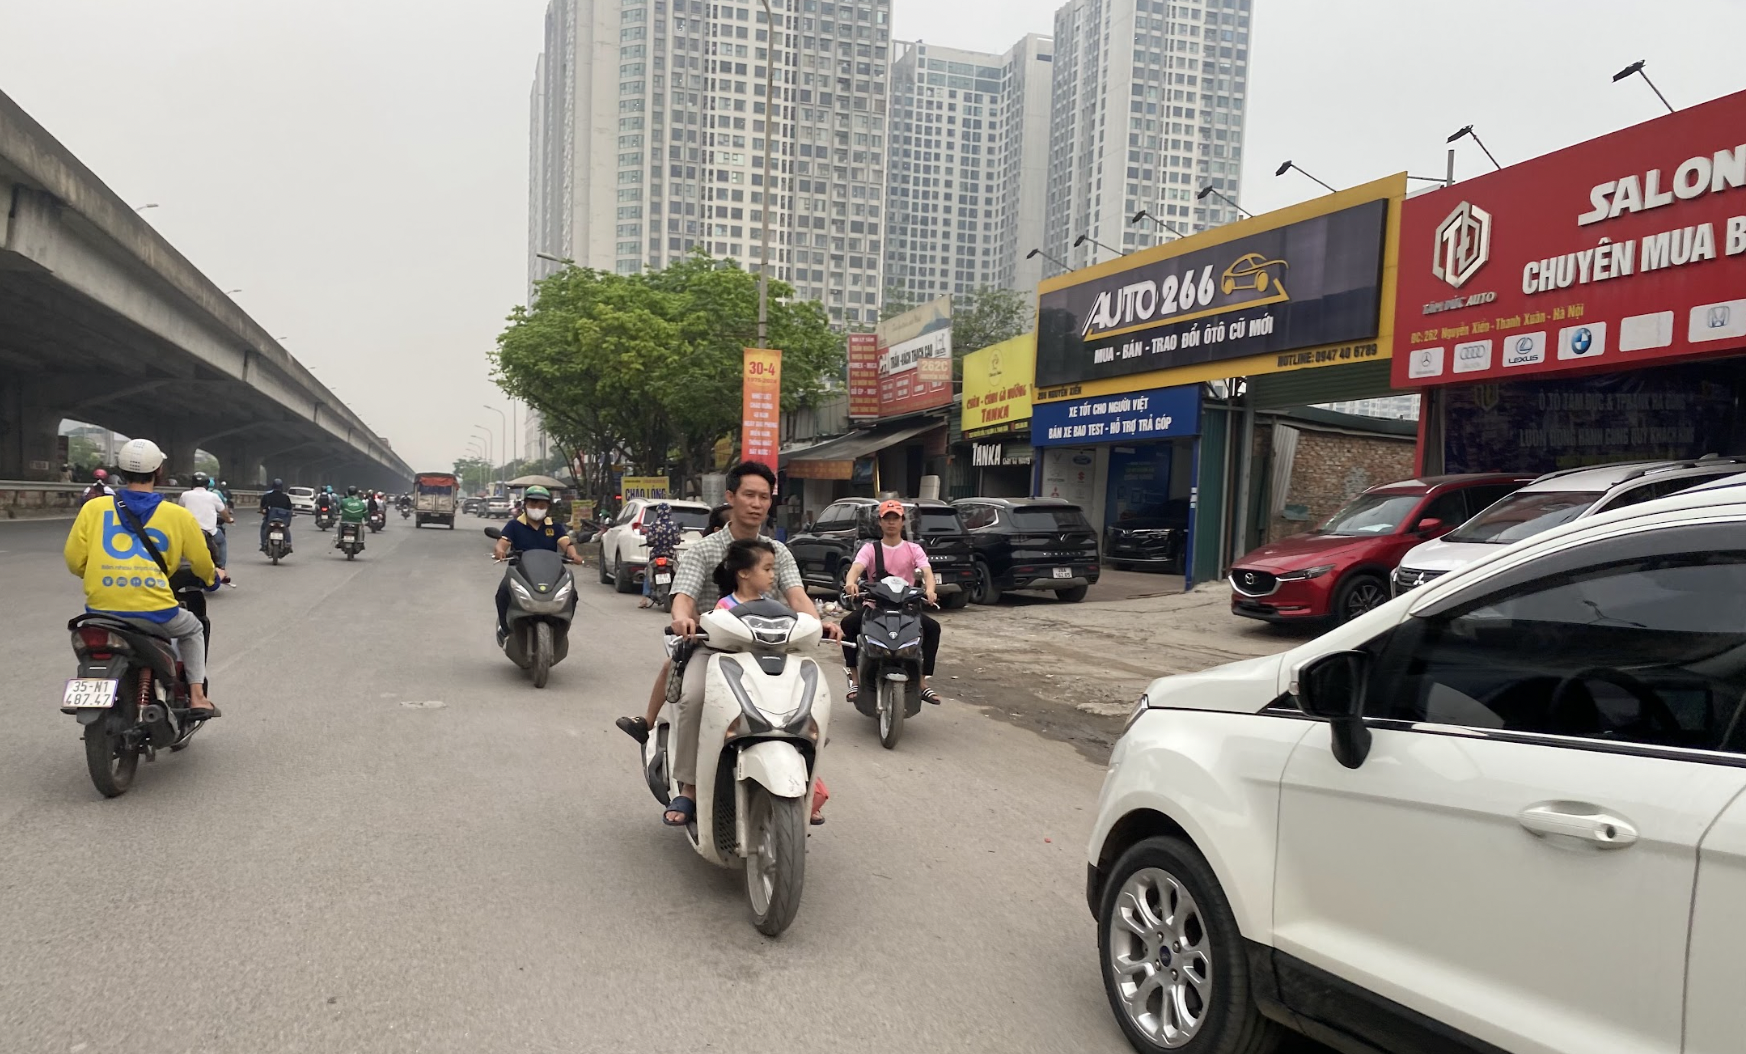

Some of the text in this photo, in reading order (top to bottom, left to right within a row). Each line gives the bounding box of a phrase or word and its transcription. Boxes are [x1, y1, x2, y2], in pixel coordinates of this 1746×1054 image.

[1578, 144, 1746, 226] SALON
[1522, 237, 1636, 295] CHUYÊN
[1640, 222, 1715, 272] MUA
[1082, 264, 1215, 336] AUTO 266
[1466, 291, 1496, 306] AUTO
[1496, 315, 1521, 331] Thanh
[1523, 310, 1546, 326] Xuân
[1553, 306, 1566, 321] Hà
[1568, 303, 1584, 320] Nội
[1094, 347, 1115, 364] MUA
[1122, 339, 1143, 359] BÁN
[1152, 336, 1178, 354] TRAO
[1181, 322, 1200, 349] ĐỔI
[1204, 321, 1225, 344] ÔTÔ
[1229, 317, 1246, 340] CŨ
[1249, 312, 1274, 336] MỚI
[749, 361, 776, 376] 30-4
[921, 360, 948, 372] 262C
[1508, 354, 1539, 364] LEXUS
[981, 404, 1009, 423] TANKA
[1068, 395, 1149, 418] XE TỐT CHO NGƯỜI VIỆT
[1048, 424, 1062, 439] BÁN
[1063, 425, 1072, 438] XE
[1073, 424, 1087, 438] BAO
[1088, 423, 1105, 436] TEST
[1122, 418, 1137, 435] TRỢ
[1138, 413, 1153, 432] TRẢ
[1155, 413, 1172, 430] GÓP
[972, 442, 1002, 467] TANKA
[102, 510, 170, 562] be
[66, 692, 111, 706] 487.47
